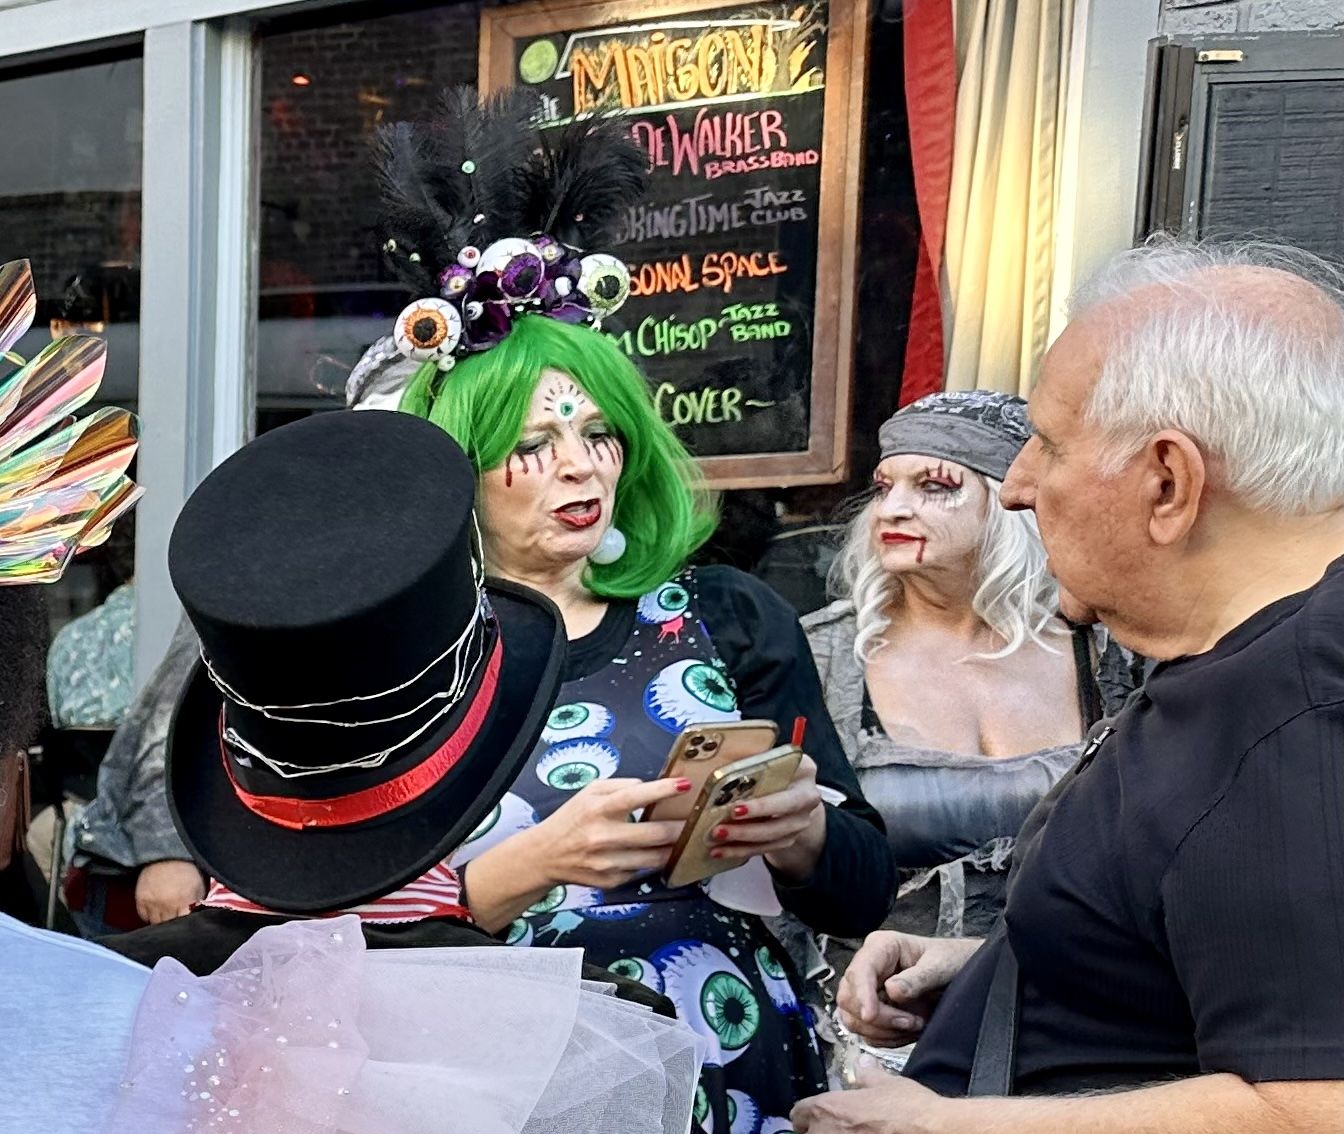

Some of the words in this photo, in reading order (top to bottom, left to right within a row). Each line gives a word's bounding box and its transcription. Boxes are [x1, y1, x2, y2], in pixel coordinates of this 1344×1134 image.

[743, 185, 807, 209] JAZZ
[750, 206, 808, 226] CLUB
[701, 252, 788, 293] SPACE
[729, 320, 791, 342] BAND
